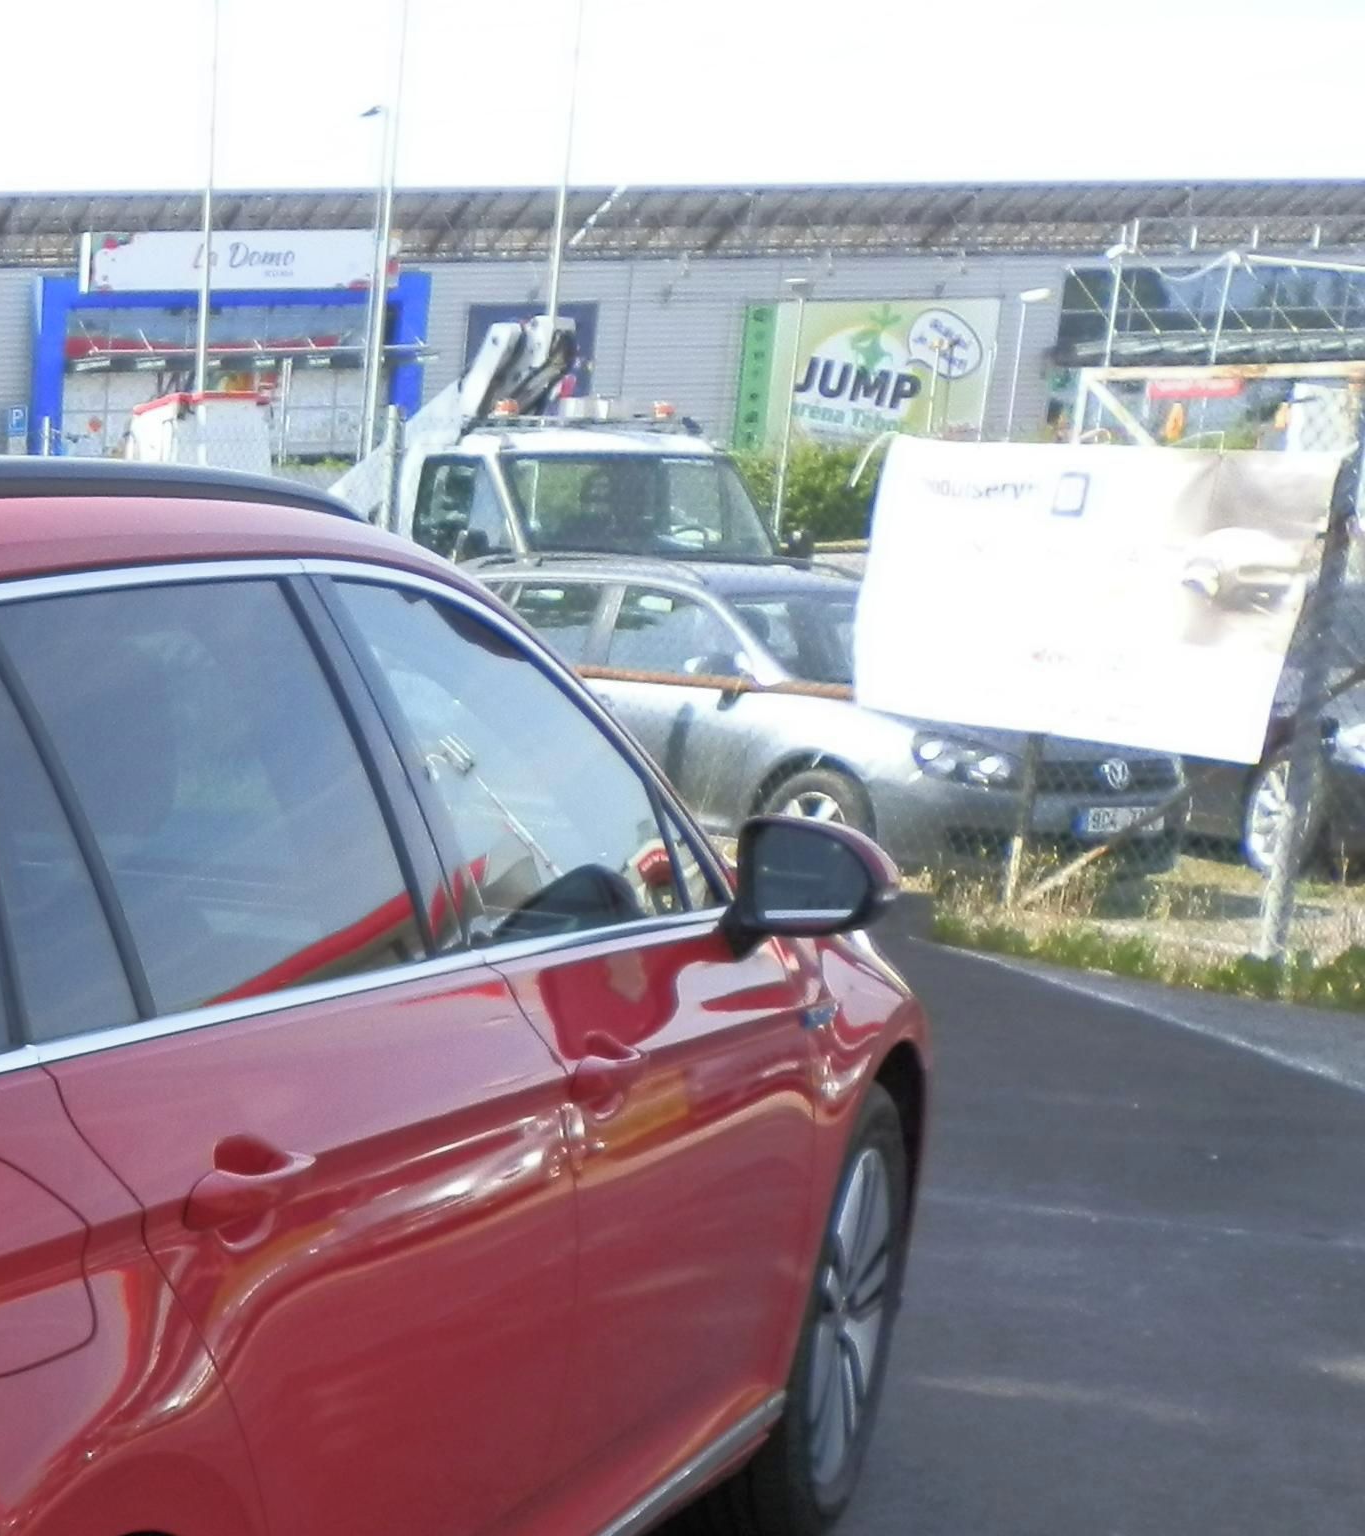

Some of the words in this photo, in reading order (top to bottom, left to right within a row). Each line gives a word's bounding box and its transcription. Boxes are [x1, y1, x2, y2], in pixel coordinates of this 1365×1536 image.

[229, 242, 296, 269] Domo
[795, 356, 922, 409] JUMP
[12, 408, 24, 426] P
